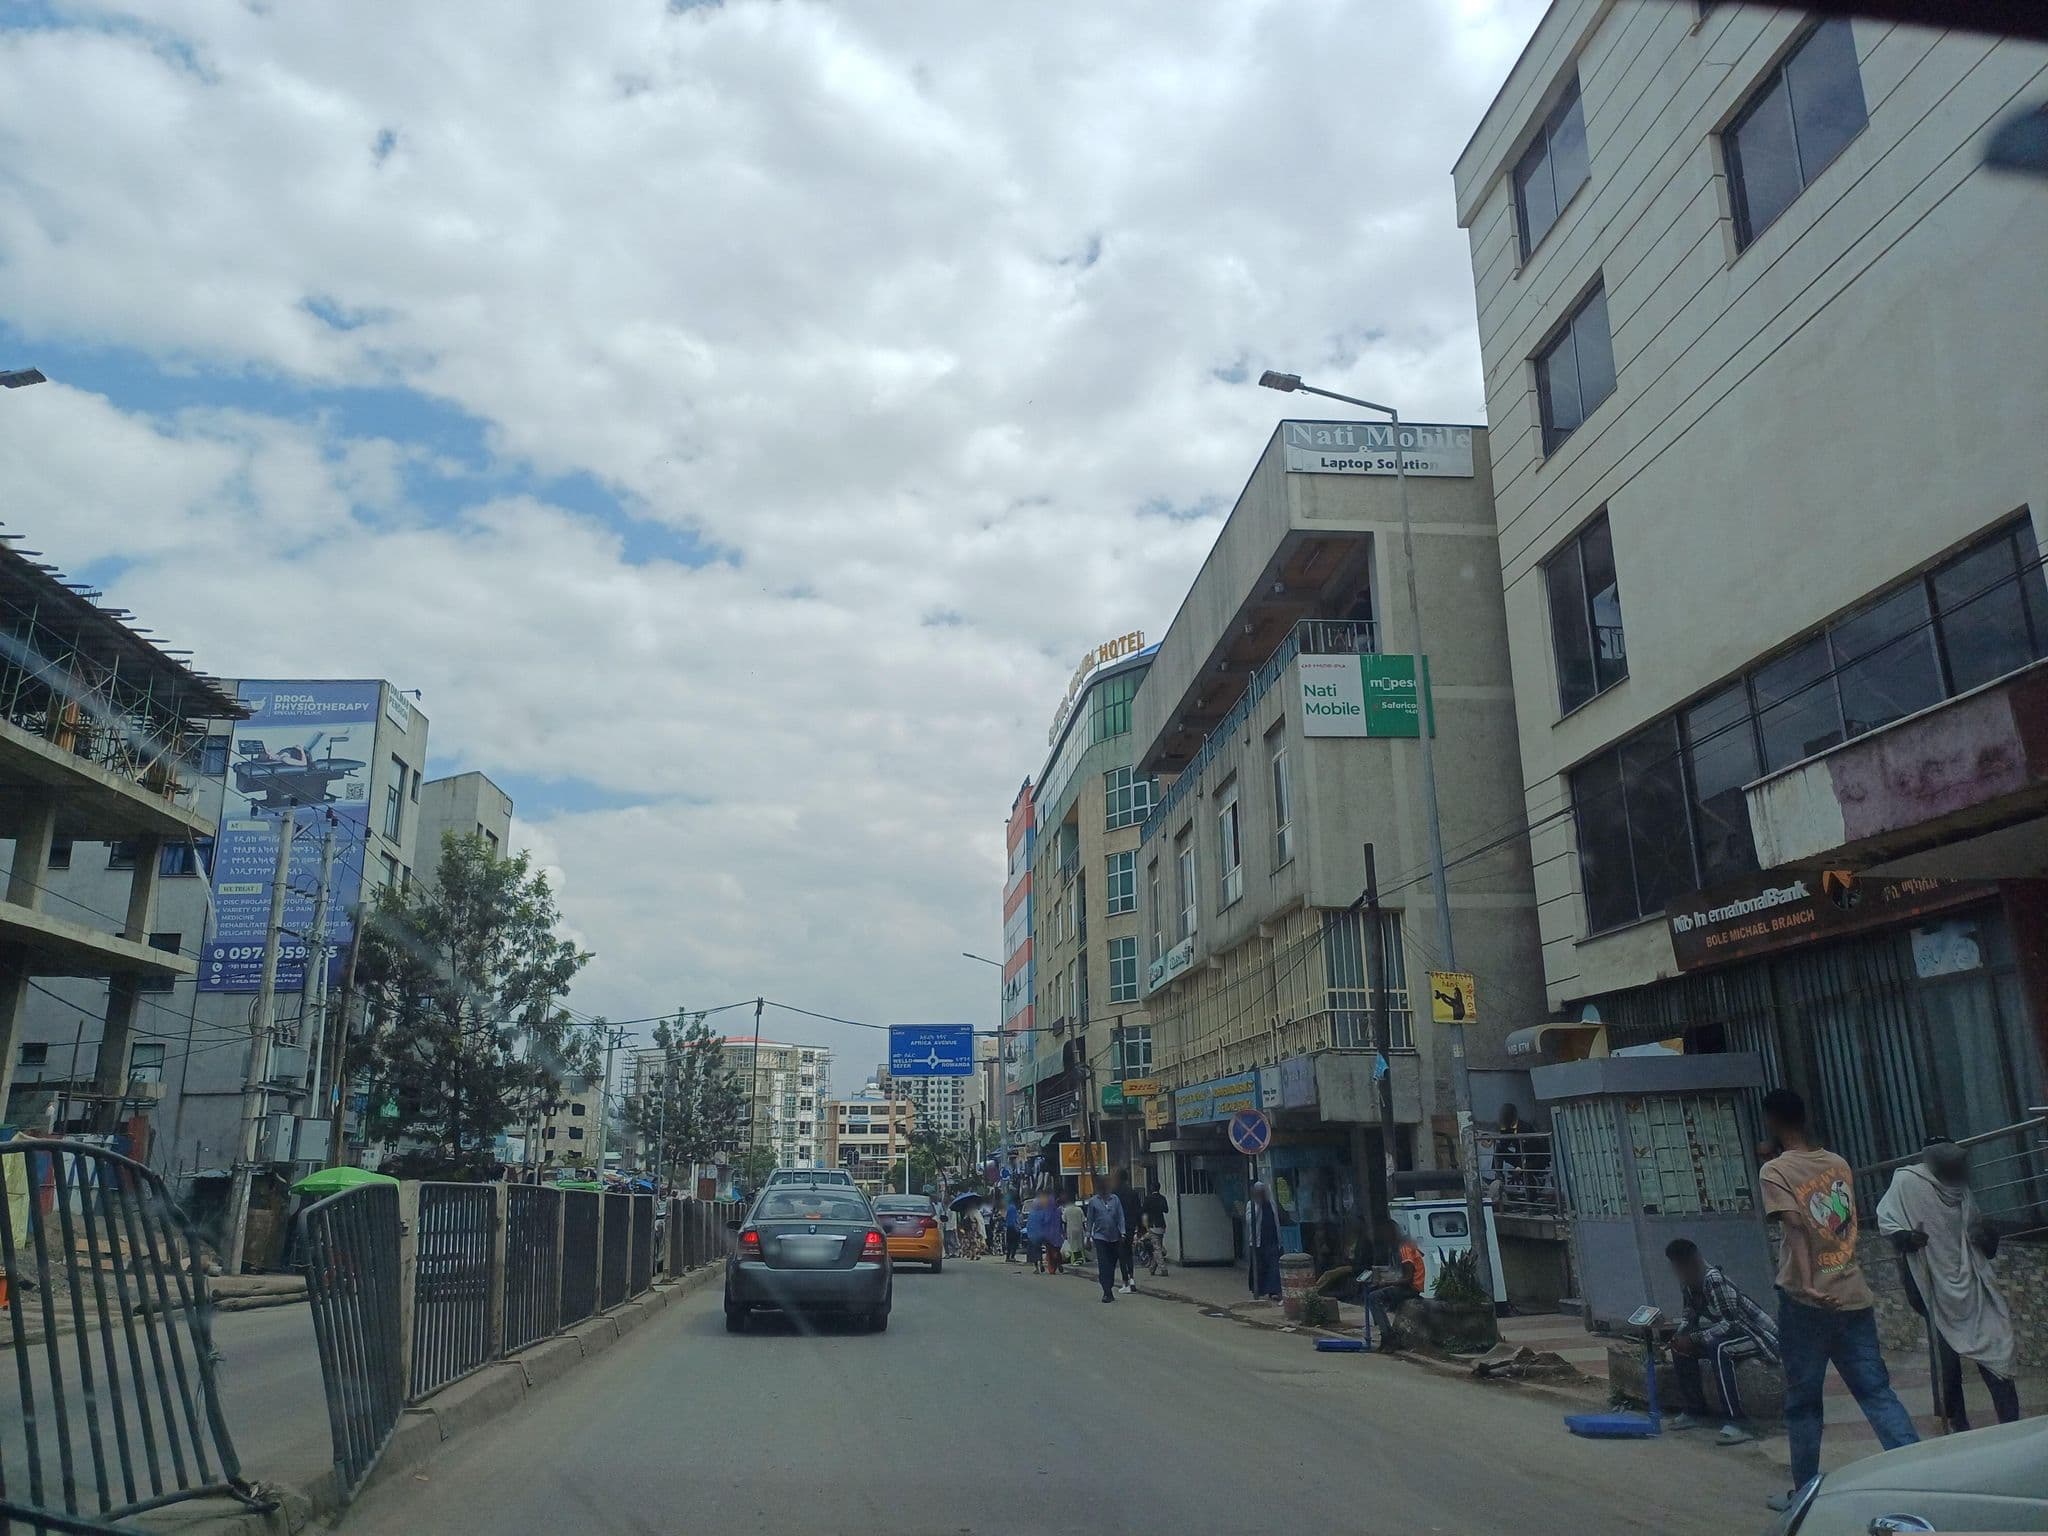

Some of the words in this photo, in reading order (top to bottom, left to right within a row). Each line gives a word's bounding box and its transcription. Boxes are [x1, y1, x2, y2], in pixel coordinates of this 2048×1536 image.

[1291, 425, 1355, 446] Nati
[1366, 425, 1471, 449] Mobile
[1320, 457, 1374, 471] Laptop
[1098, 630, 1145, 663] HOTEL
[1303, 683, 1337, 697] Nati
[275, 694, 315, 703] DROGA
[1381, 701, 1418, 710] Safarico
[273, 702, 370, 711] PHYSIOTHERAPY
[1305, 702, 1361, 716] Mobile
[222, 906, 250, 914] VARIETY
[1672, 914, 1693, 934] Nib
[1705, 932, 1729, 948] BOLE
[1730, 922, 1770, 941] MICHAEL
[1771, 909, 1815, 931] BRANCH
[219, 929, 251, 937] DELICATE
